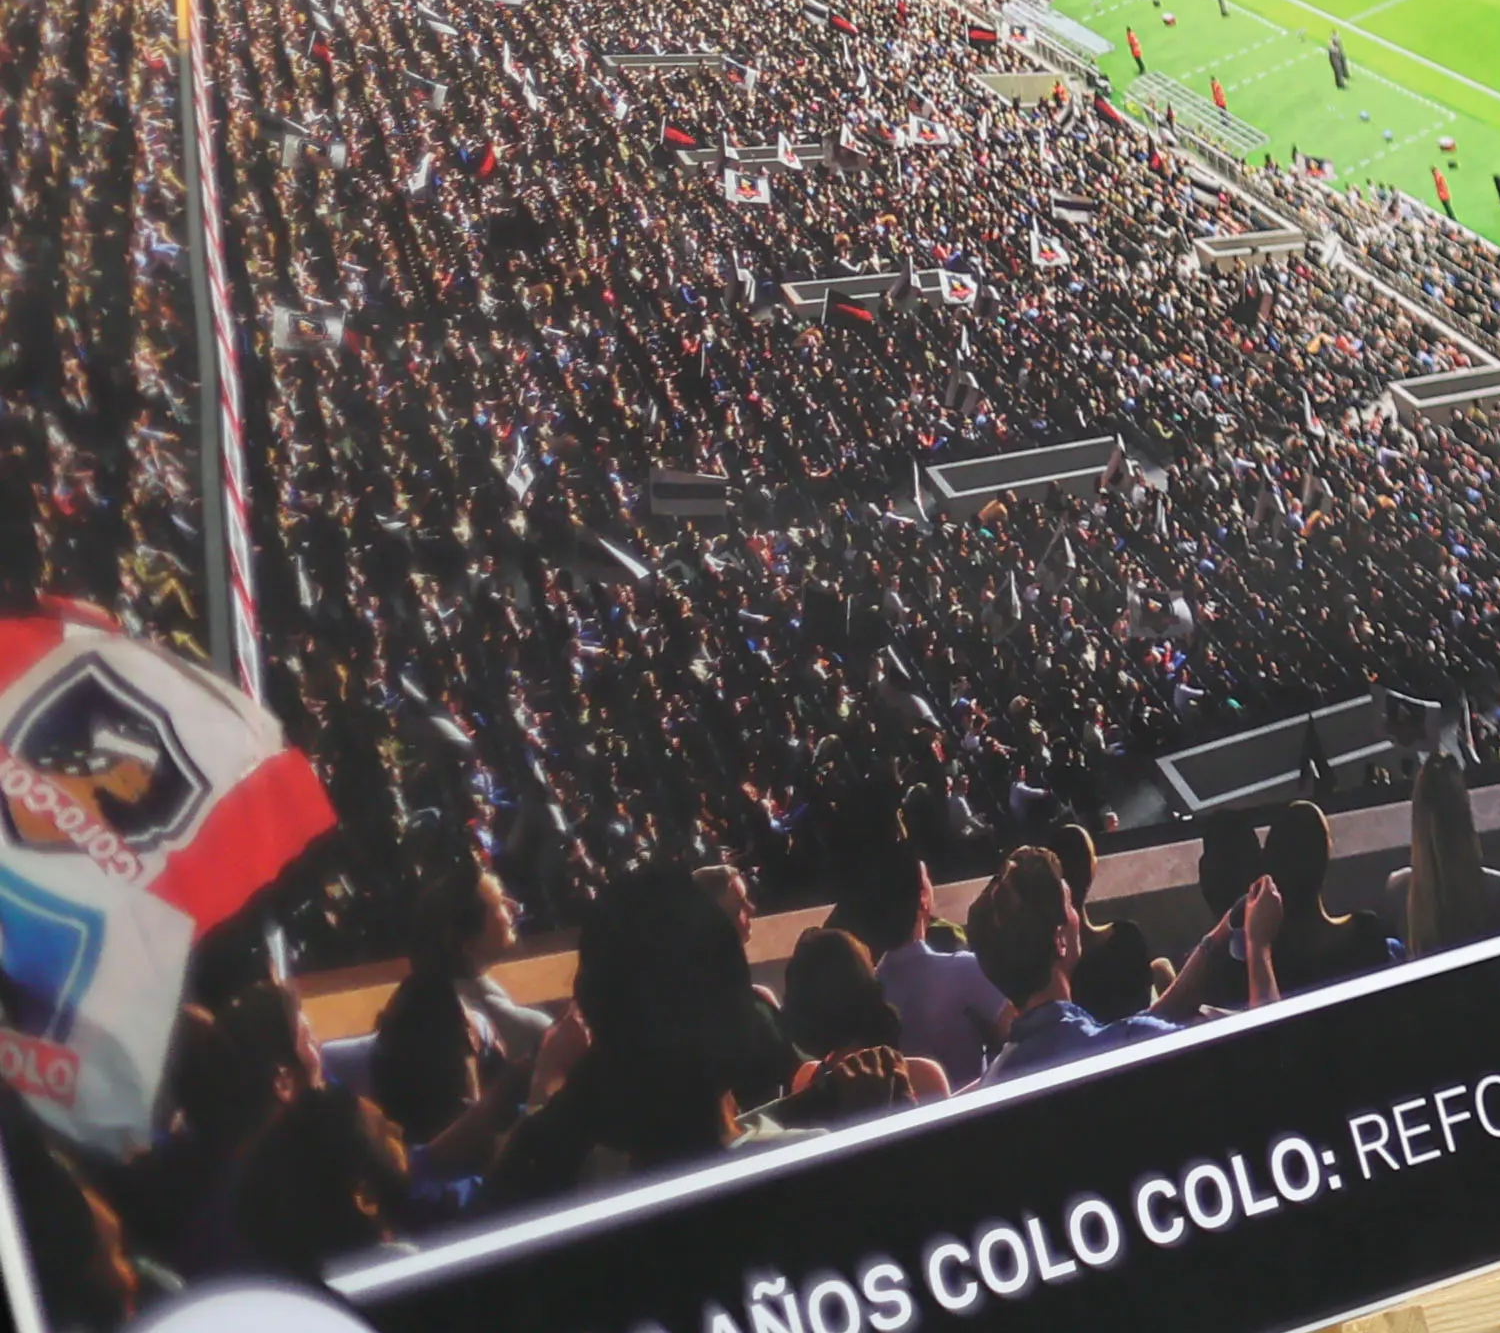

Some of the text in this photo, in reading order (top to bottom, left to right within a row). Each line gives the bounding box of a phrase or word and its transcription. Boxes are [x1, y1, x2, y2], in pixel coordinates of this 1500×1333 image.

[707, 1263, 913, 1333] ÑOS
[928, 1199, 1121, 1310] COLO
[1135, 1137, 1343, 1245] COLO:
